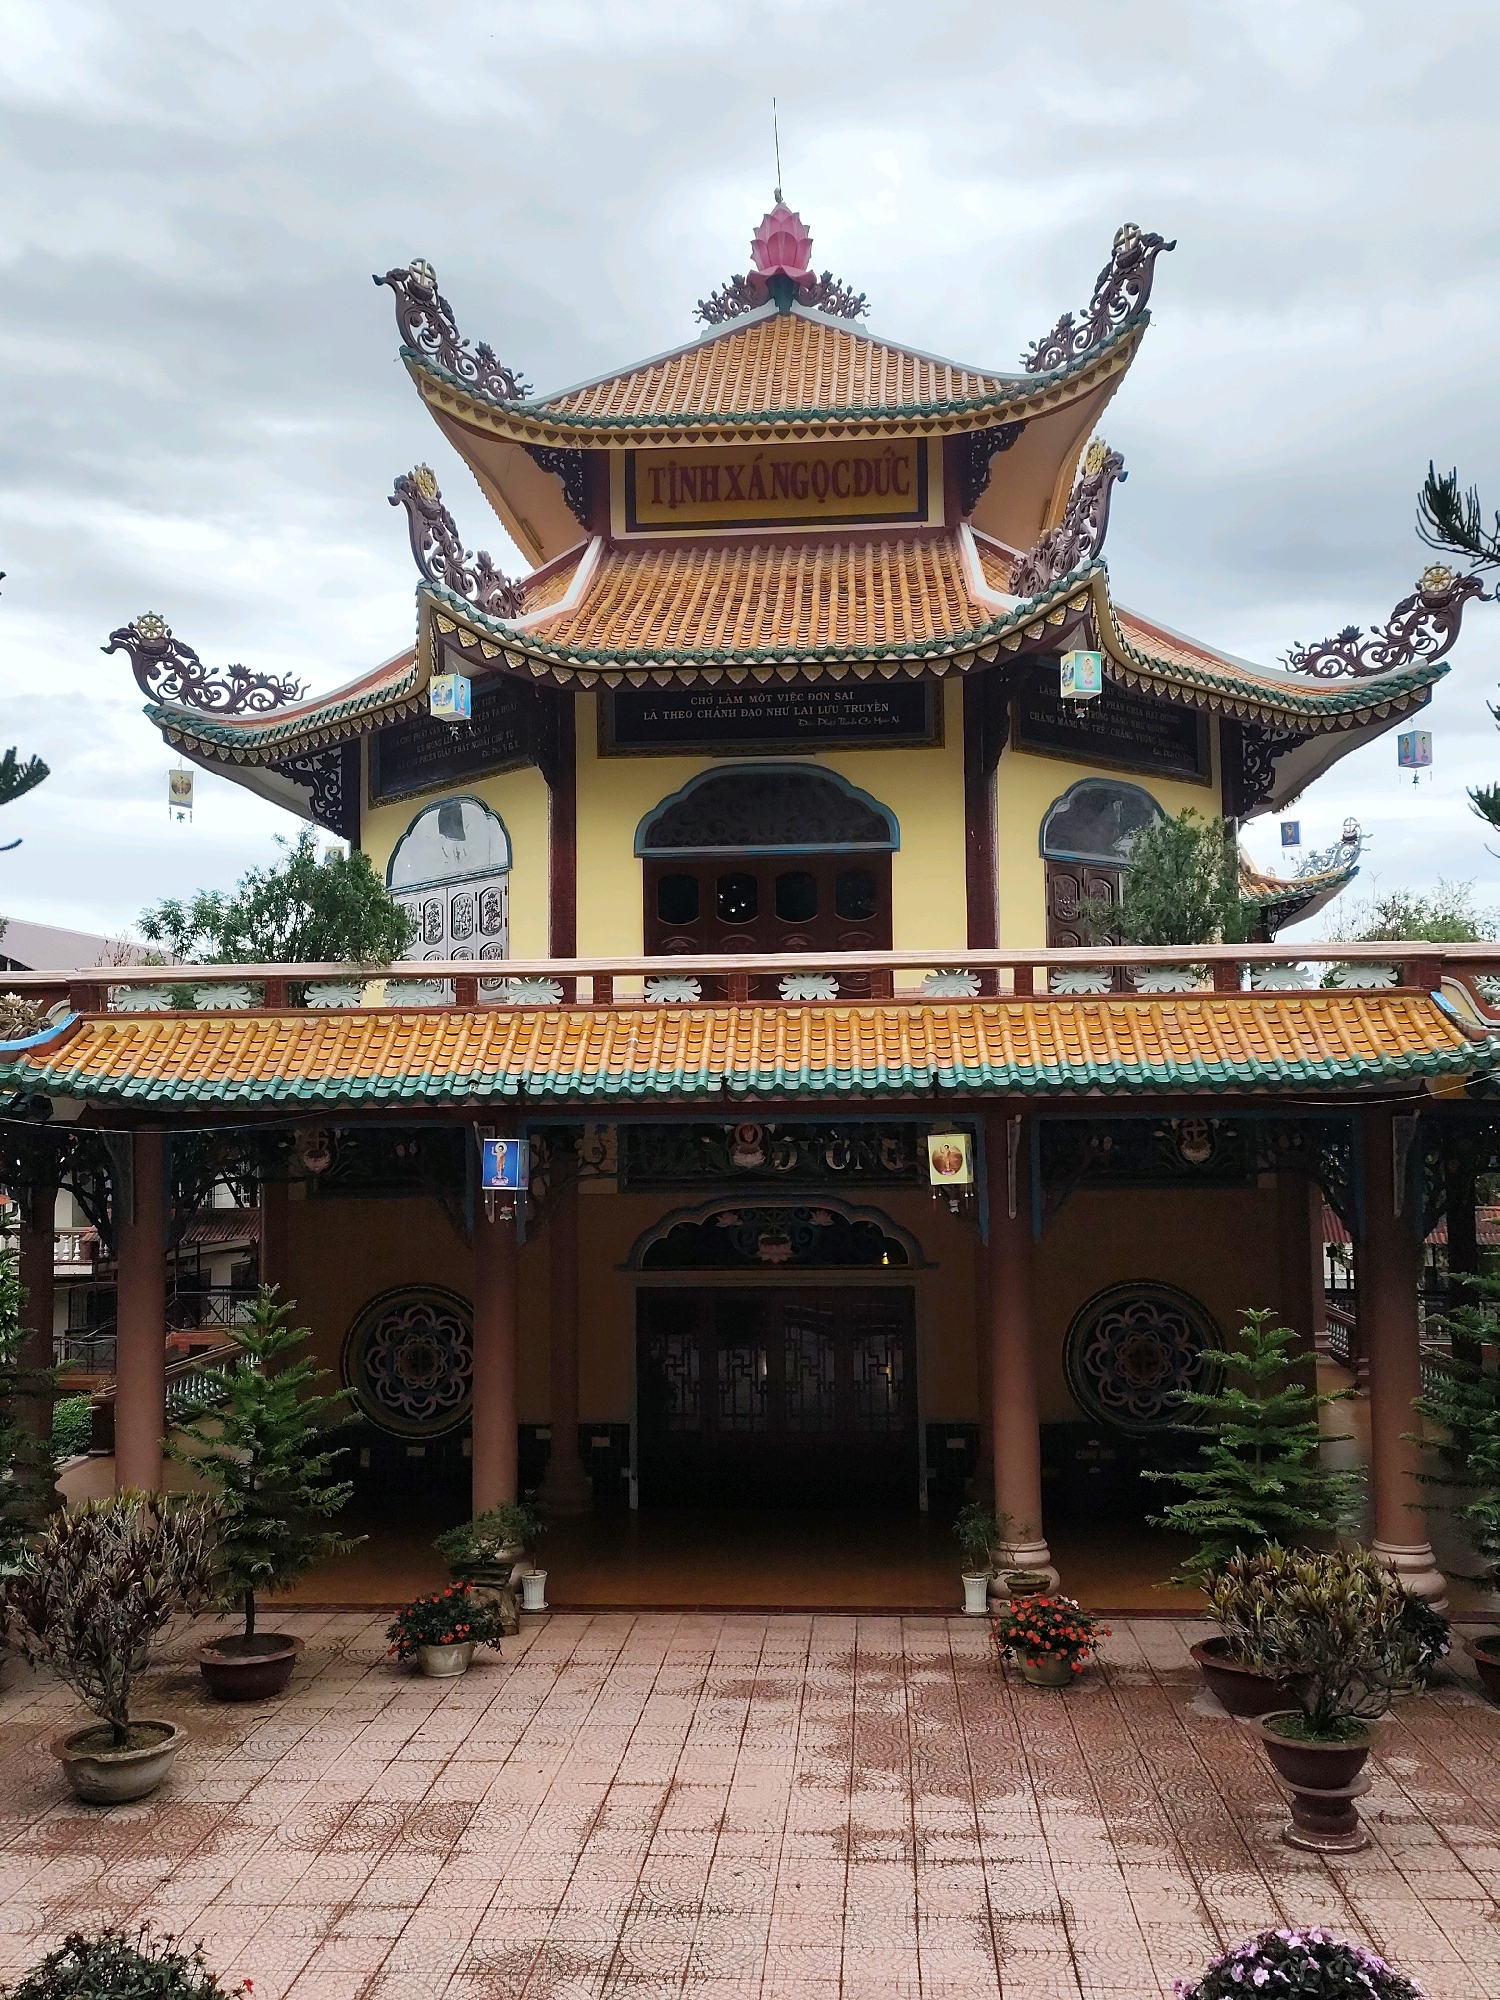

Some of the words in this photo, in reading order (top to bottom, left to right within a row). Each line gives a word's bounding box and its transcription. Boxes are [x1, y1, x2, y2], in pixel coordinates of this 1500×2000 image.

[834, 691, 855, 701] SAI
[663, 710, 693, 719] THEO
[697, 705, 737, 718] CHÁNH
[766, 705, 790, 717] NHƯ
[794, 706, 814, 715] LAI
